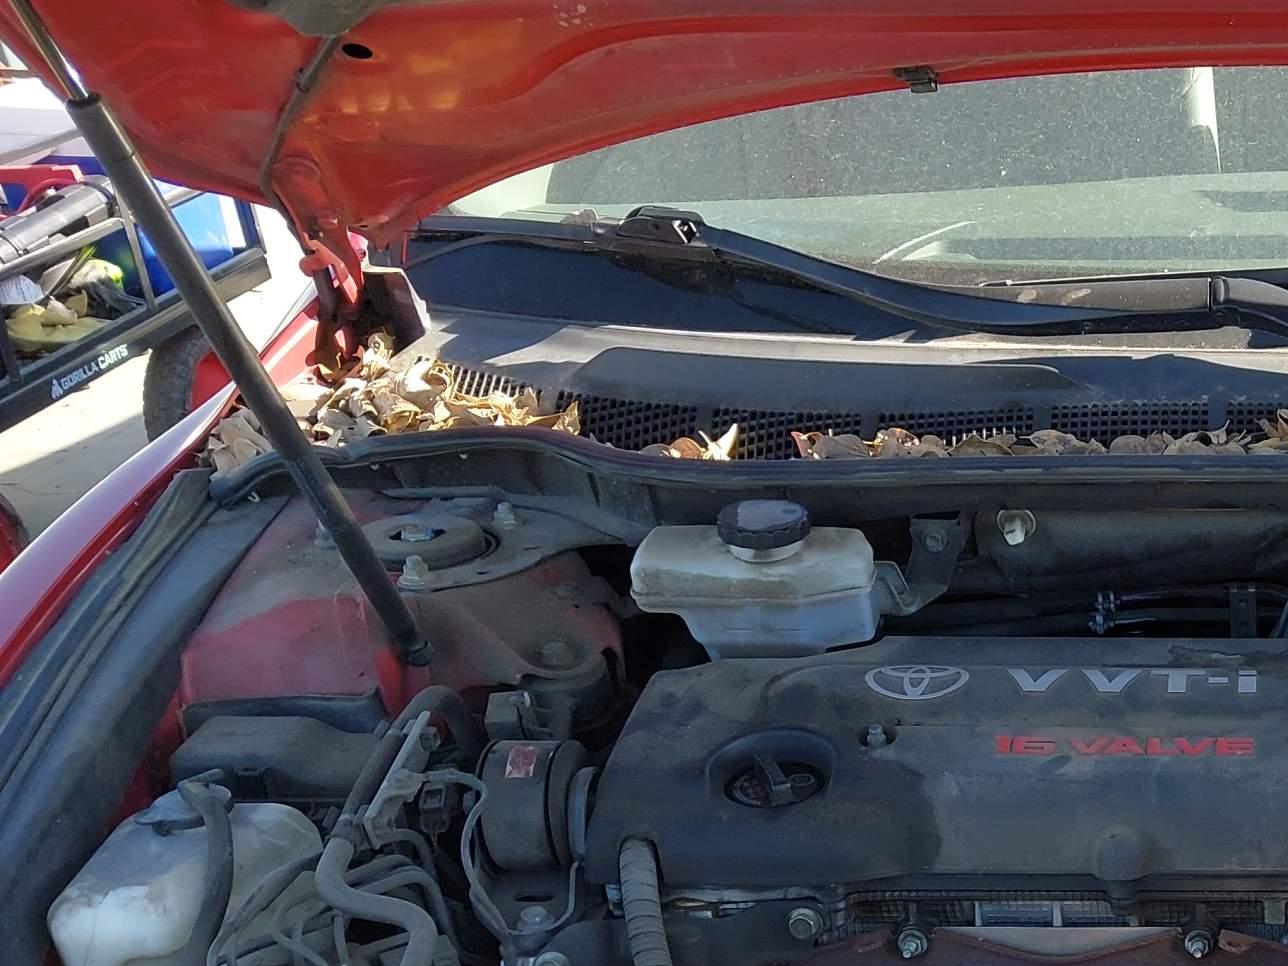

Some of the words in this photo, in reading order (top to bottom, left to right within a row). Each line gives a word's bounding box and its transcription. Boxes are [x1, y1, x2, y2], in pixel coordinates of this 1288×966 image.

[61, 361, 99, 390] GORILLA
[97, 344, 128, 369] CARTS
[1006, 668, 1257, 693] VVT-i
[995, 736, 1056, 755] 16
[1071, 736, 1256, 756] VALVE
